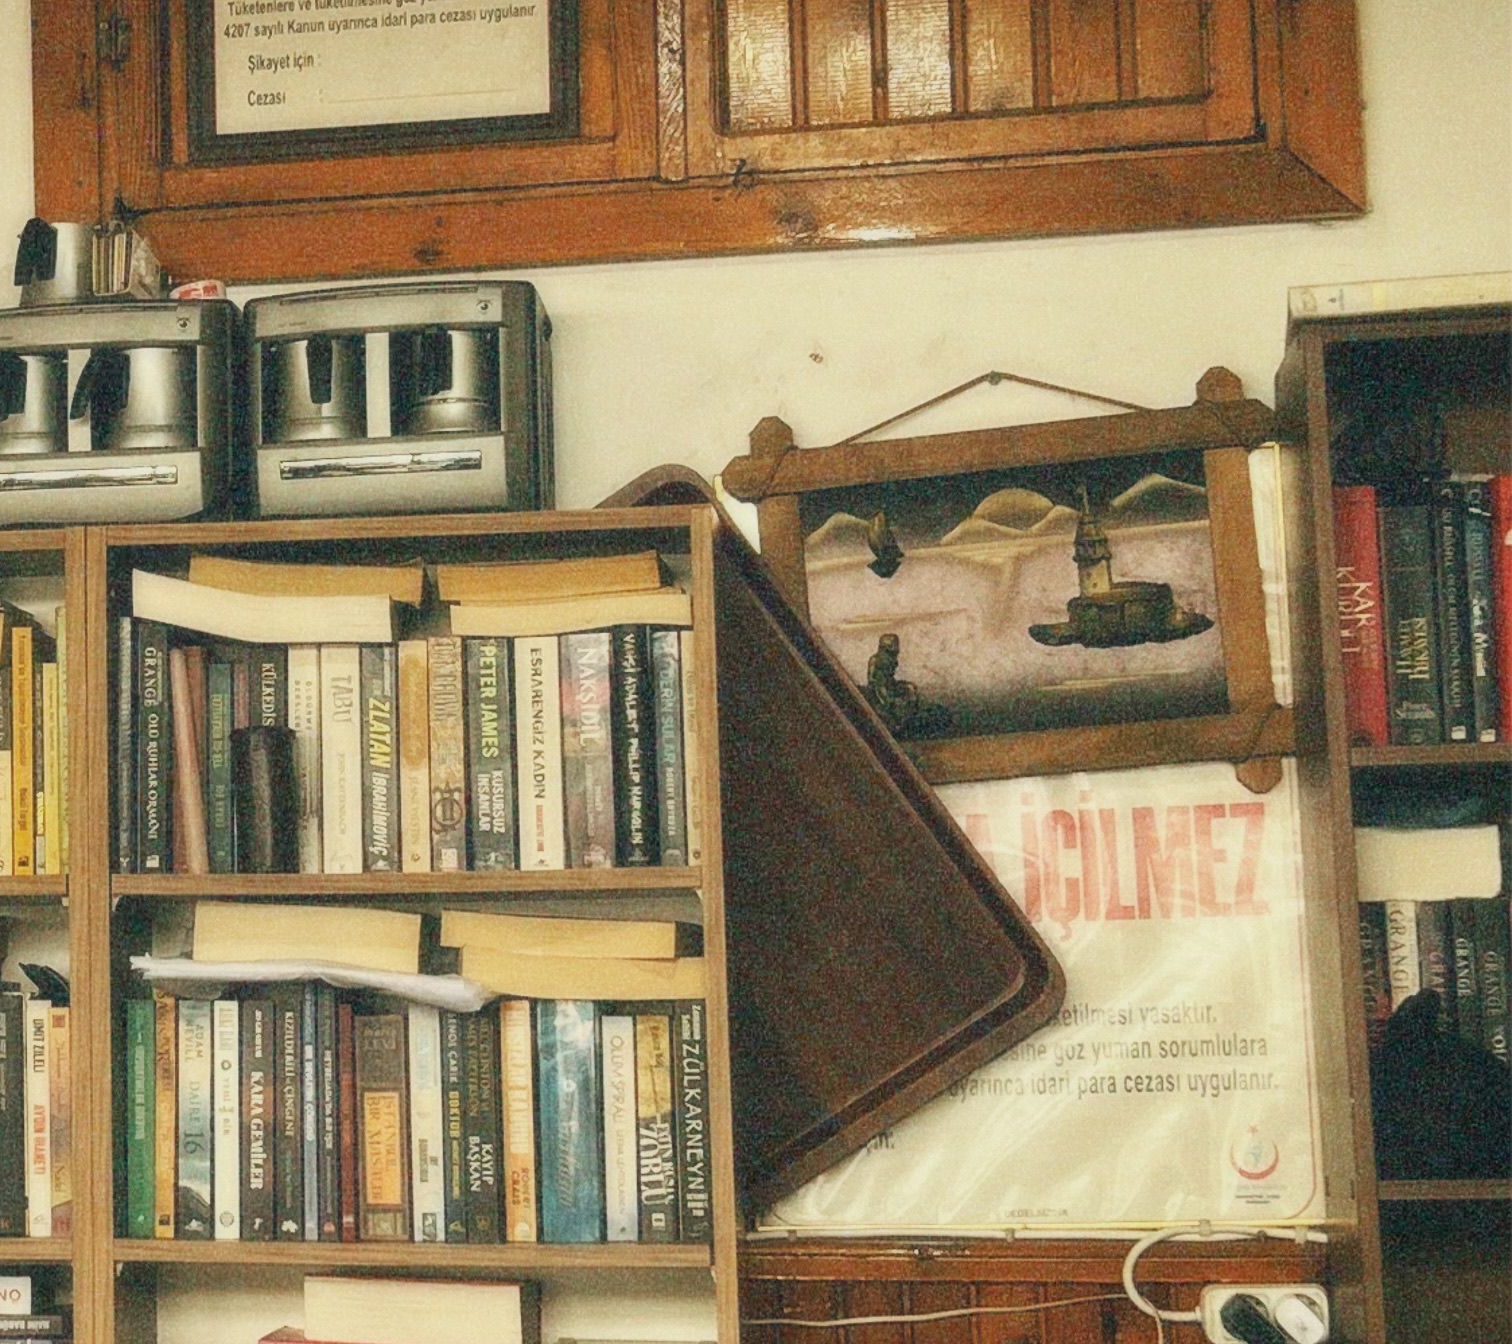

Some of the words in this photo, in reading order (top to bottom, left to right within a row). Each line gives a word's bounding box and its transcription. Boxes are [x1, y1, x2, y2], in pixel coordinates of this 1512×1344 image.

[224, 23, 251, 39] 4207
[287, 18, 325, 34] Kanun
[410, 12, 437, 29] para
[439, 8, 477, 24] cezası
[227, 0, 294, 17] Tüketenlere
[297, 0, 312, 12] ve
[248, 51, 291, 73] Şikayet
[293, 49, 315, 69] için
[247, 88, 286, 107] Cezası
[479, 646, 498, 698] PETER
[530, 647, 546, 745] ESRARENGİZ
[330, 674, 354, 724] TABU
[368, 698, 391, 768] ZLATAN
[481, 703, 499, 758] JAMES
[661, 715, 677, 763] SULAR
[147, 741, 158, 789] RUHLAR
[532, 750, 546, 799] KADIN
[368, 772, 391, 856] İBRAHİMOVİÇ
[477, 774, 492, 831] İNSANLAR
[491, 770, 505, 834] KUSURSUZ
[1020, 791, 1270, 941] İÇİLMEZ
[1158, 1033, 1268, 1060] sorumlulara
[250, 1071, 265, 1113] KARA
[1078, 1076, 1118, 1101] para
[1123, 1070, 1182, 1094] cezası
[682, 1044, 706, 1190] ZÜLKARNEYN
[183, 1131, 205, 1155] 16
[249, 1118, 268, 1189] GEMİLER
[466, 1136, 481, 1192] BAŞKAN
[480, 1143, 494, 1186] KAYIP
